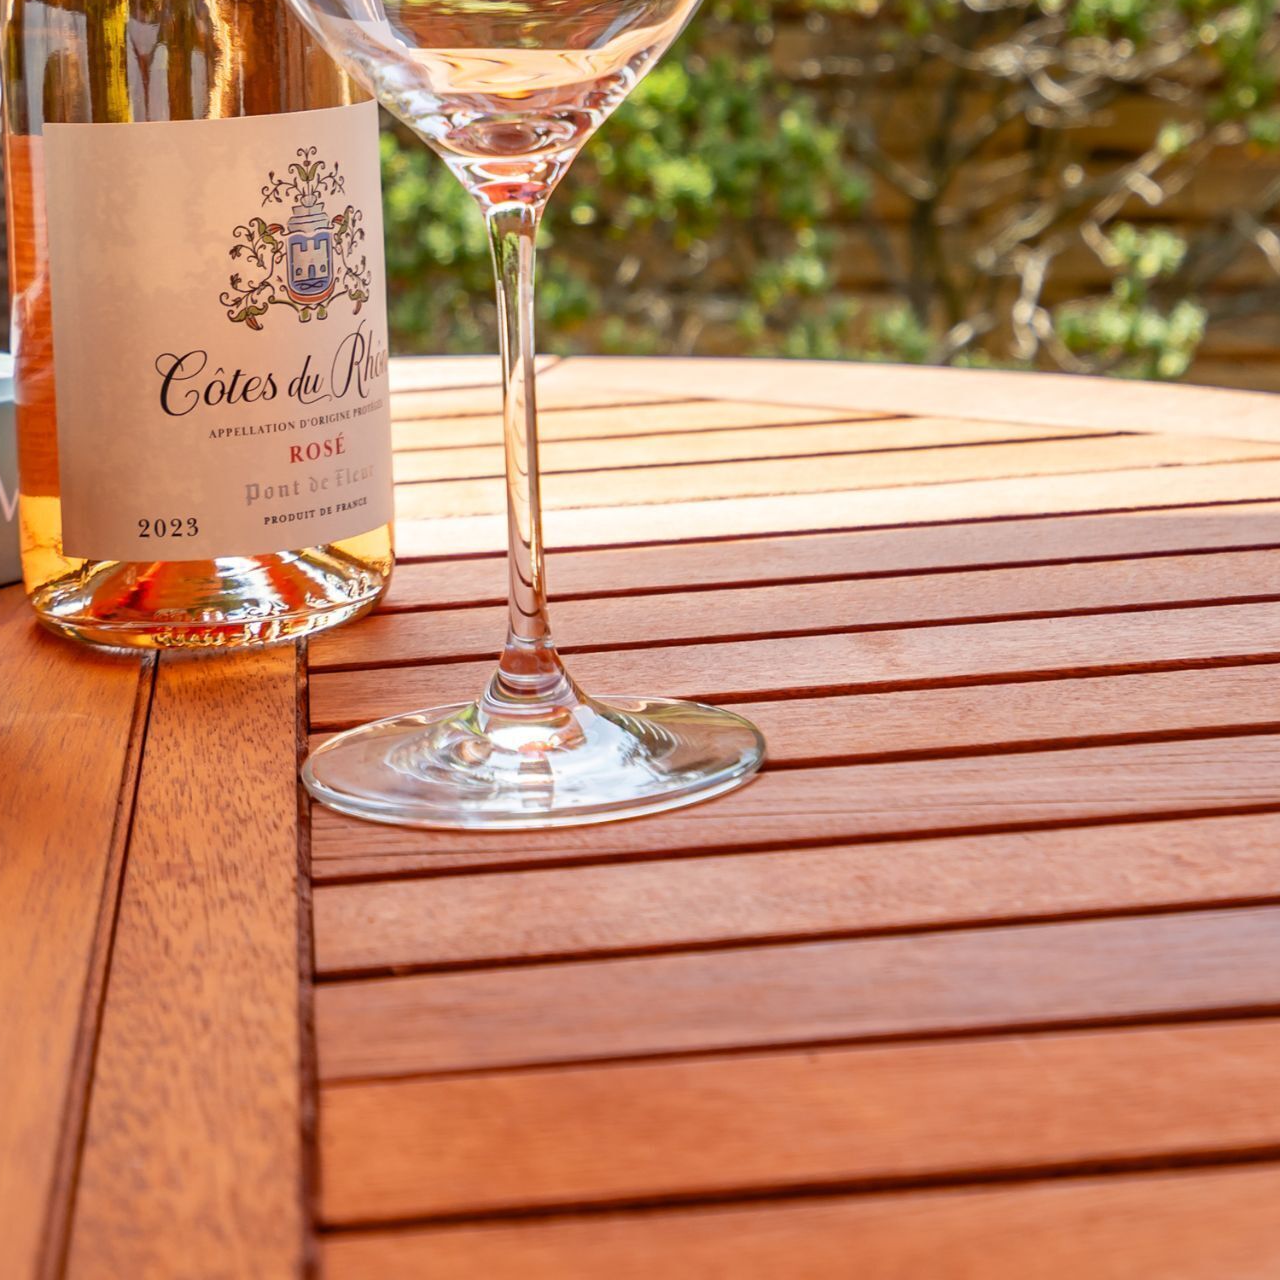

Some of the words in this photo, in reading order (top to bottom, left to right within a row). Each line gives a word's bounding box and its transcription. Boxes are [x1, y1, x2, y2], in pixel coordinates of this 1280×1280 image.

[155, 349, 278, 417] Côtes
[288, 354, 333, 405] du
[208, 420, 296, 439] APPELLATION
[299, 410, 351, 430] D'ORIGINE
[289, 432, 346, 464] ROSÉ
[245, 479, 301, 506] Pont
[308, 476, 329, 494] de
[263, 509, 317, 525] PRODUIT
[320, 505, 333, 517] DE
[336, 496, 368, 513] FRANCE
[137, 517, 199, 538] 2023
